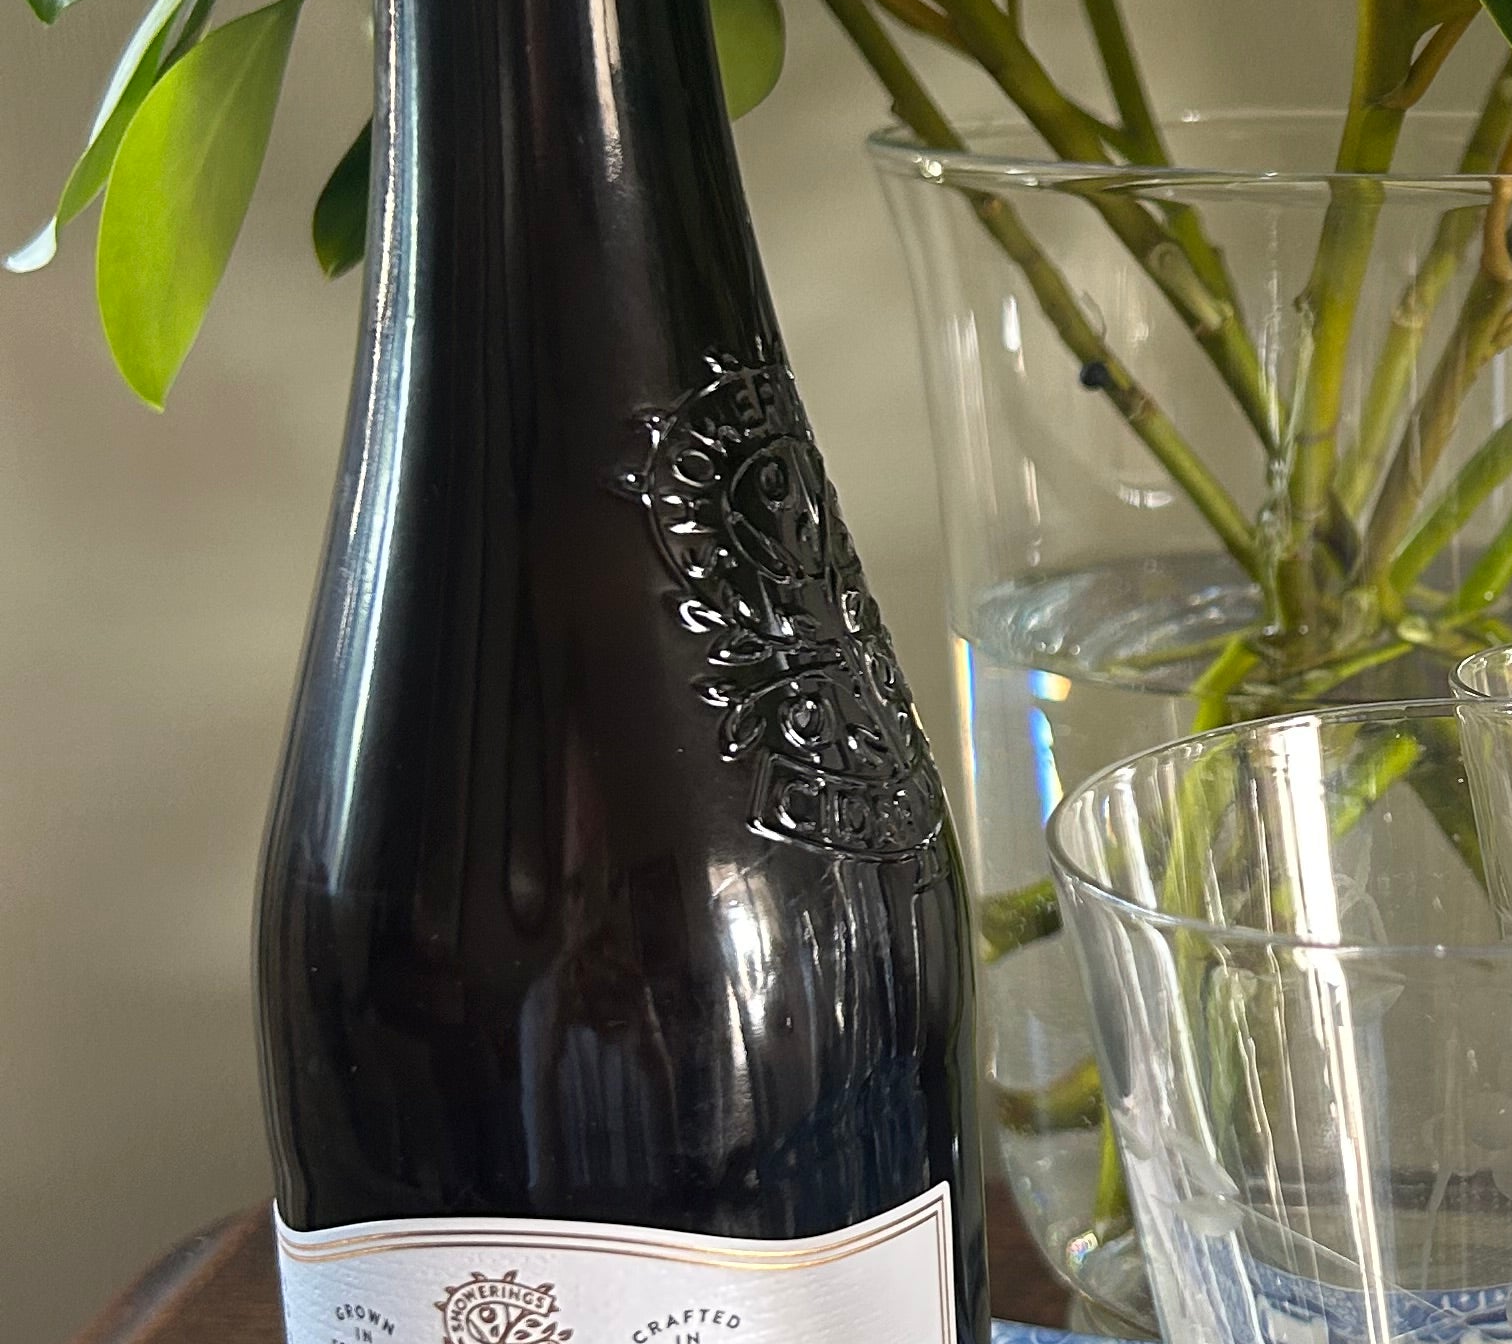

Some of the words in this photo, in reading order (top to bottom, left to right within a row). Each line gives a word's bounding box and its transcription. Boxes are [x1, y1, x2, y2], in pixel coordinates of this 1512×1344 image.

[335, 1304, 396, 1336] GROWN
[450, 1285, 548, 1334] SHOWERINGS
[632, 1308, 741, 1344] CRAFTED
[354, 1327, 373, 1343] IN
